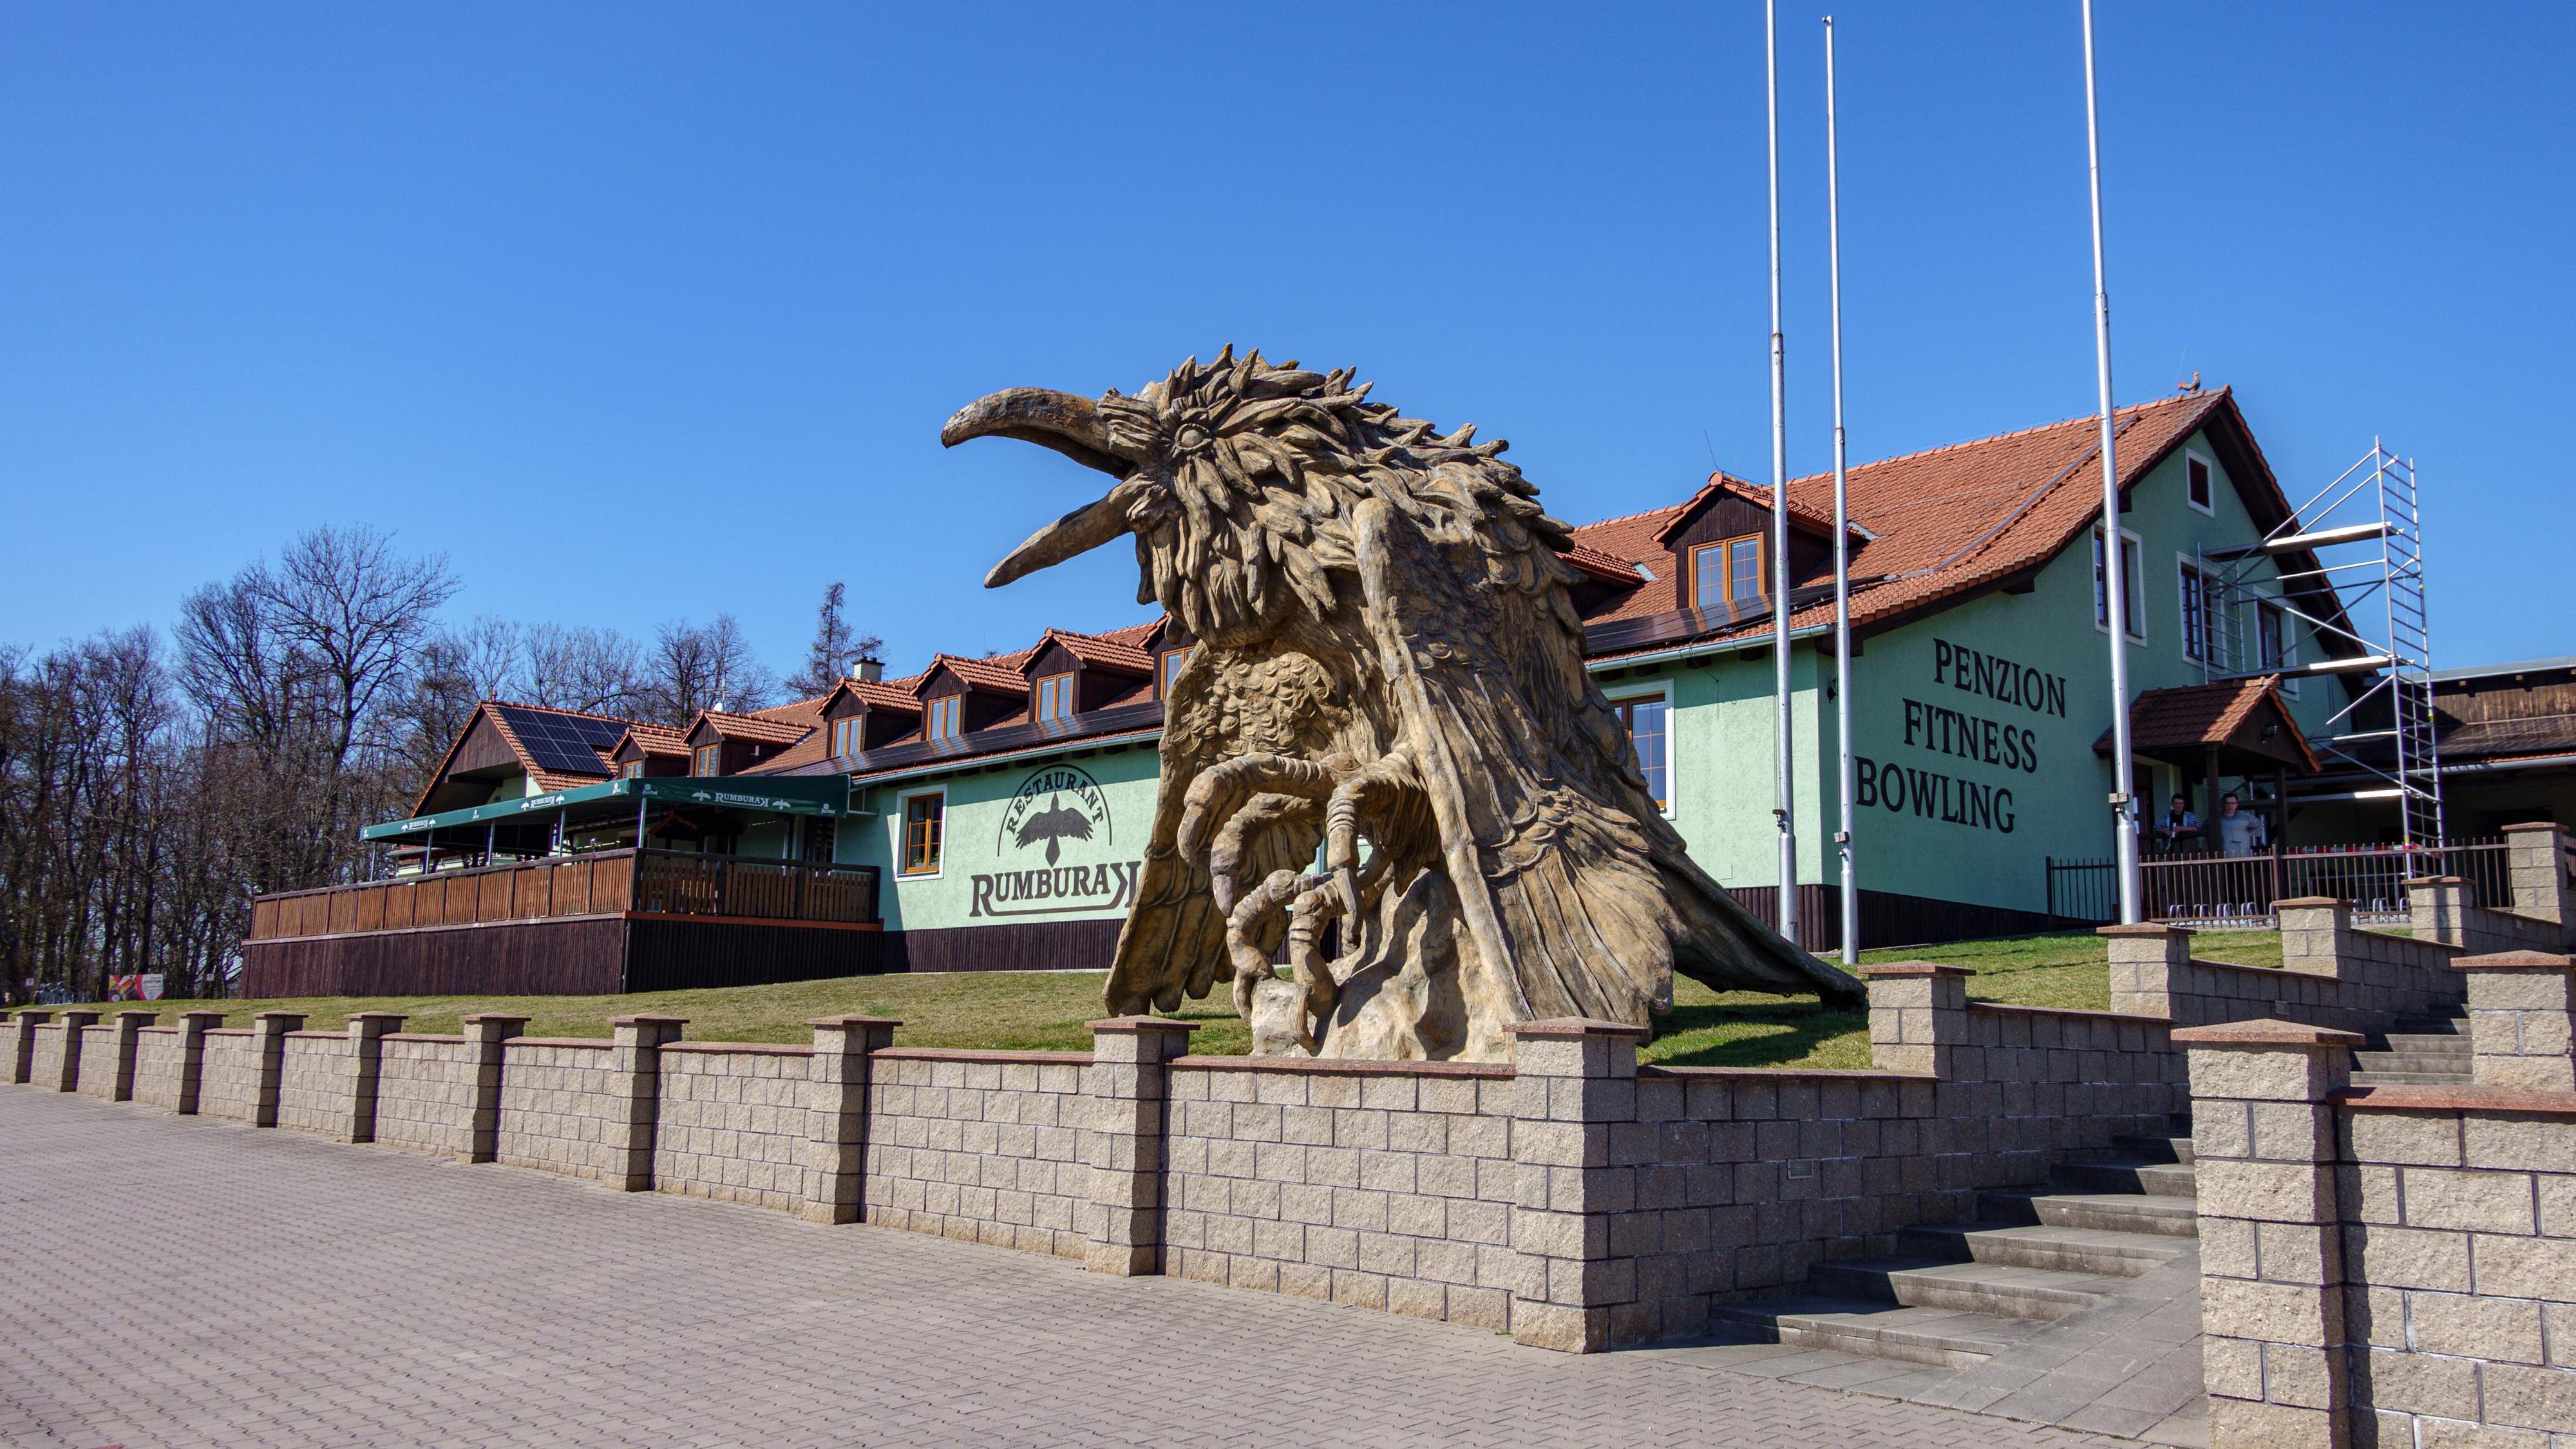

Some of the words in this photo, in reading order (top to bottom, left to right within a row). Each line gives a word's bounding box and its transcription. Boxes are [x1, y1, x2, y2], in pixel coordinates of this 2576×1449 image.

[1933, 638, 2066, 718] PENZION
[1902, 697, 2037, 773] FITNESS
[715, 793, 770, 807] RUMBURAK
[1006, 772, 1104, 835] RESTAURANT
[1855, 755, 2015, 834] BOWLING
[969, 860, 1142, 917] RUMBURAK
